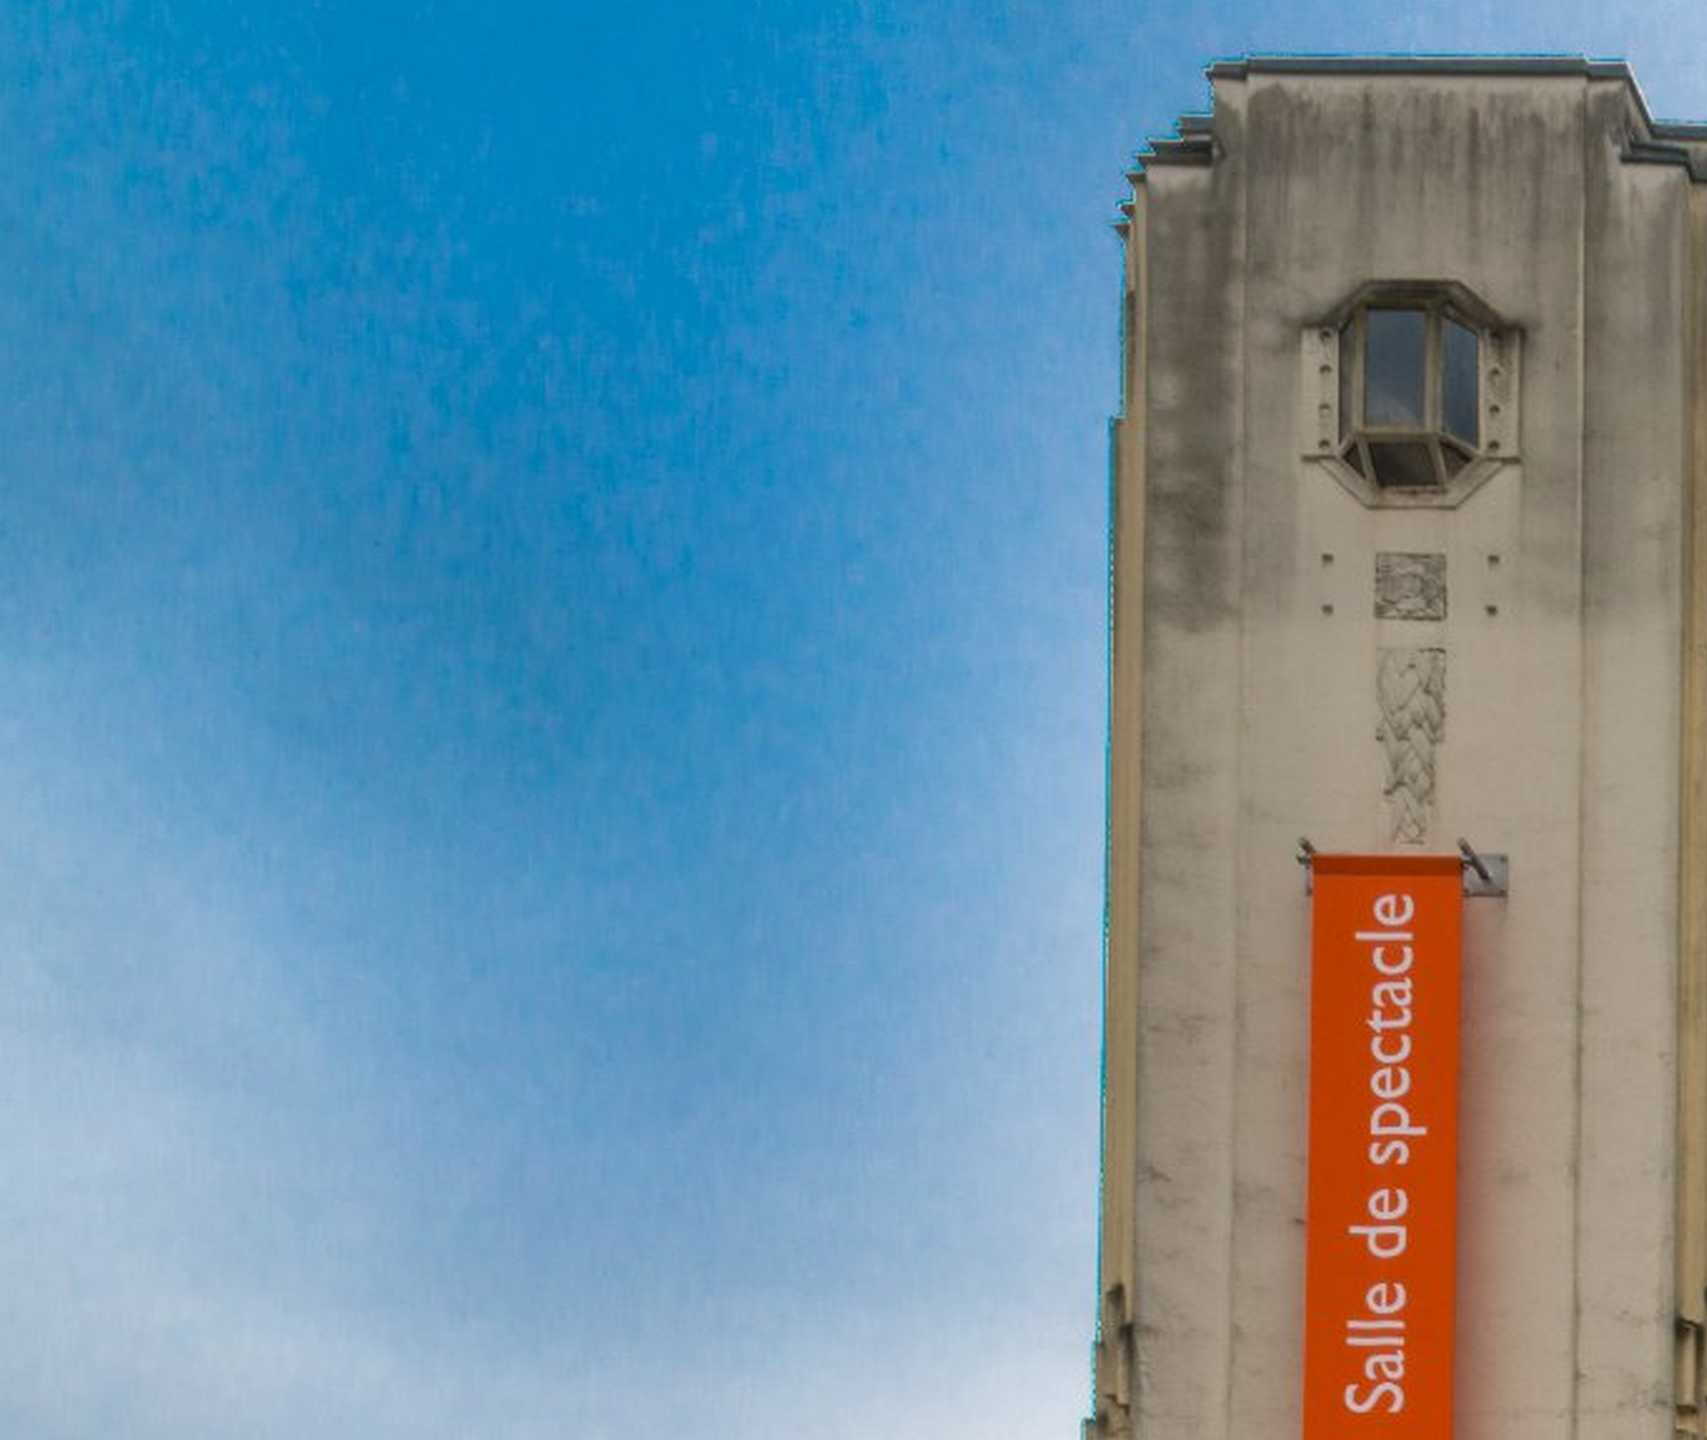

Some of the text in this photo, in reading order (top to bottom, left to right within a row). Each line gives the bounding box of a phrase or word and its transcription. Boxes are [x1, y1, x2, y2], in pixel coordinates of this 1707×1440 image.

[1345, 894, 1427, 1414] Salle de spectacle
